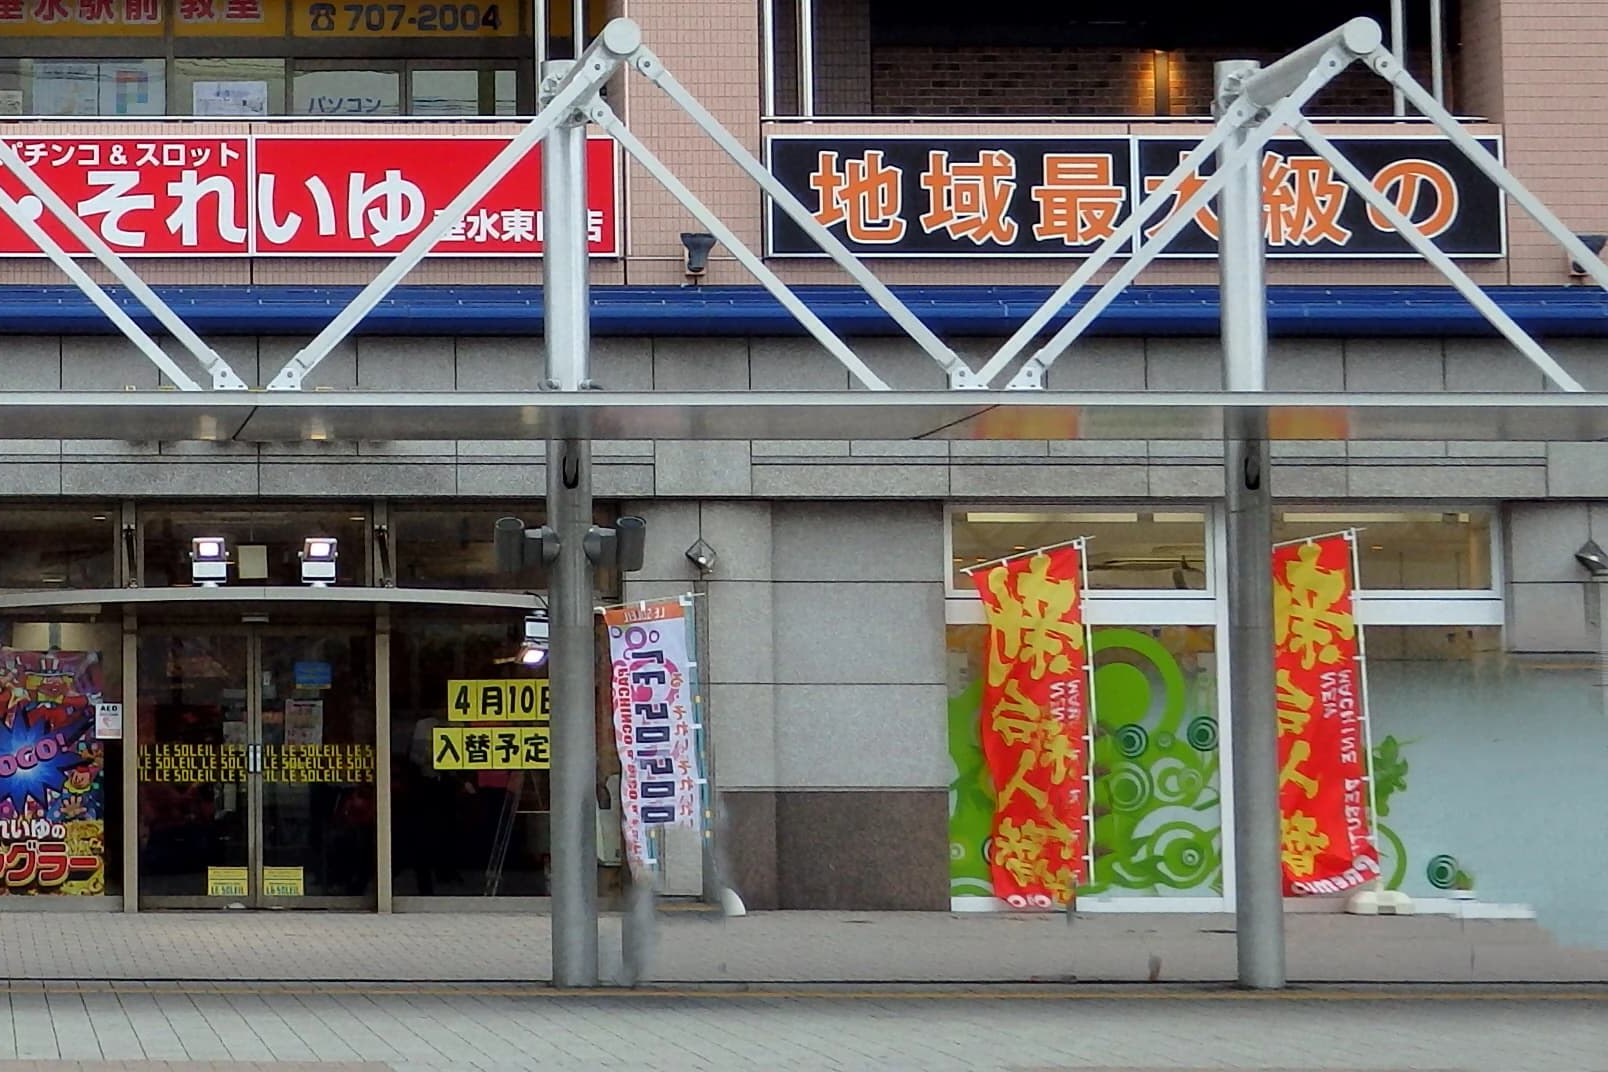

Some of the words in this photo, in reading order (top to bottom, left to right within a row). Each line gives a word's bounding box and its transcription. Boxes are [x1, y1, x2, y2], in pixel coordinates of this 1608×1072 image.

[344, 4, 501, 31] 707-2004
[156, 744, 170, 756] LE
[174, 744, 216, 756] SOLEIL
[221, 744, 236, 756] LE
[281, 744, 296, 757] LE
[301, 744, 342, 757] SOLEIL
[347, 744, 361, 757] LE
[436, 733, 550, 764] 入替予定
[138, 757, 151, 769] LE
[156, 757, 198, 769] SOLEIL
[202, 757, 216, 769] LE
[264, 757, 278, 769] LE
[282, 757, 324, 769] SOLEIL
[329, 757, 343, 769] LE
[156, 770, 170, 782] LE
[174, 770, 216, 782] SOLEIL
[221, 770, 235, 782] LE
[281, 770, 297, 782] LE
[301, 770, 343, 782] SOLEIL
[347, 770, 362, 782] LE
